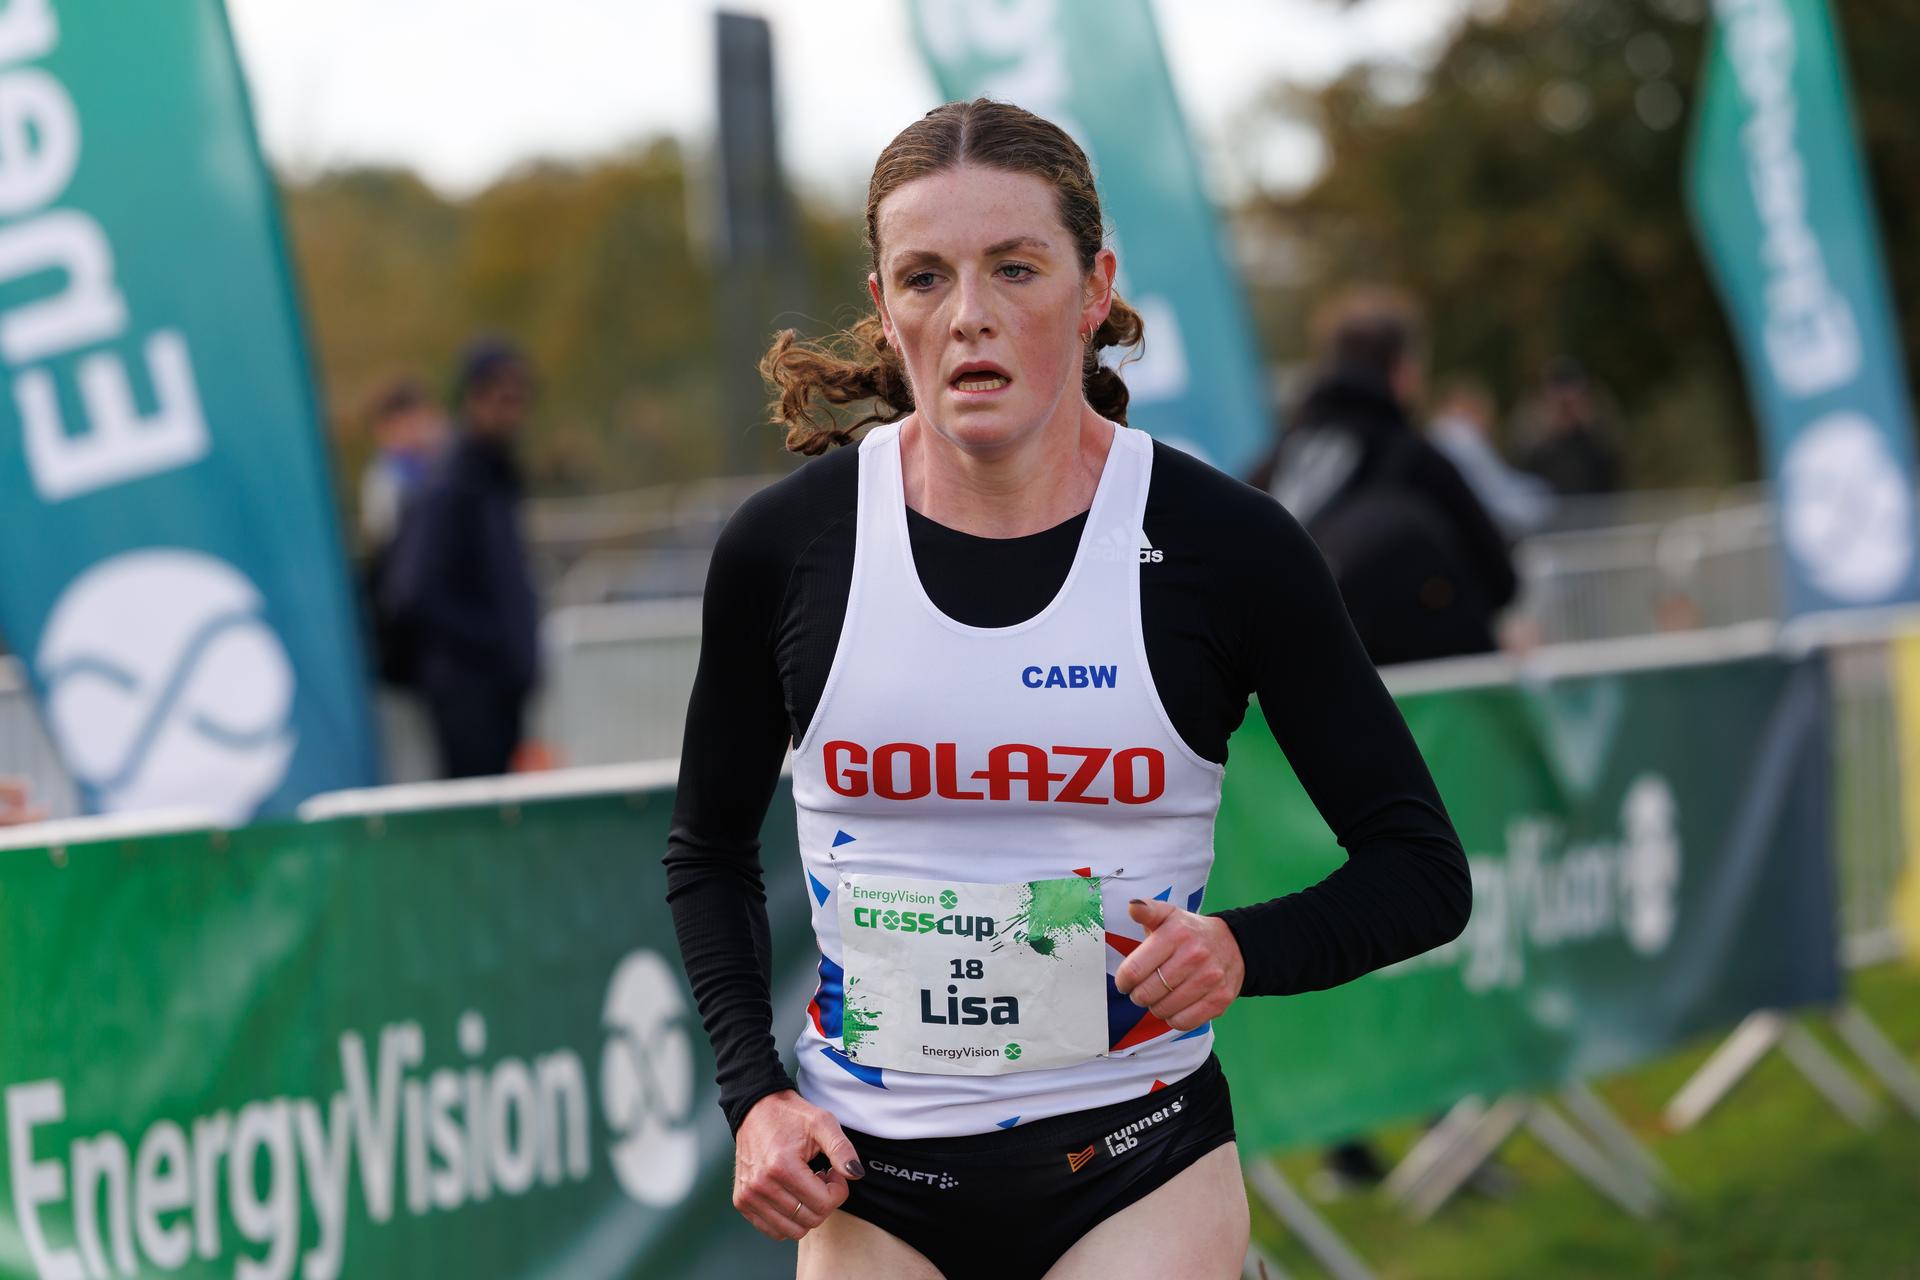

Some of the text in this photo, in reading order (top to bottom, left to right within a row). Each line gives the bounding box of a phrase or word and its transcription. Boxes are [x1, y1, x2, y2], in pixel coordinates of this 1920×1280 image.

[1021, 665, 1118, 689] CABW
[822, 740, 1165, 805] GOLAZO
[852, 886, 935, 905] EnergyVision
[949, 958, 984, 980] 18
[920, 984, 1020, 1026] Lisa
[922, 1045, 1000, 1060] EnergyVision
[4, 1010, 594, 1280] EnergyVision
[1108, 1136, 1138, 1158] lab
[868, 1159, 939, 1185] CRAFT
